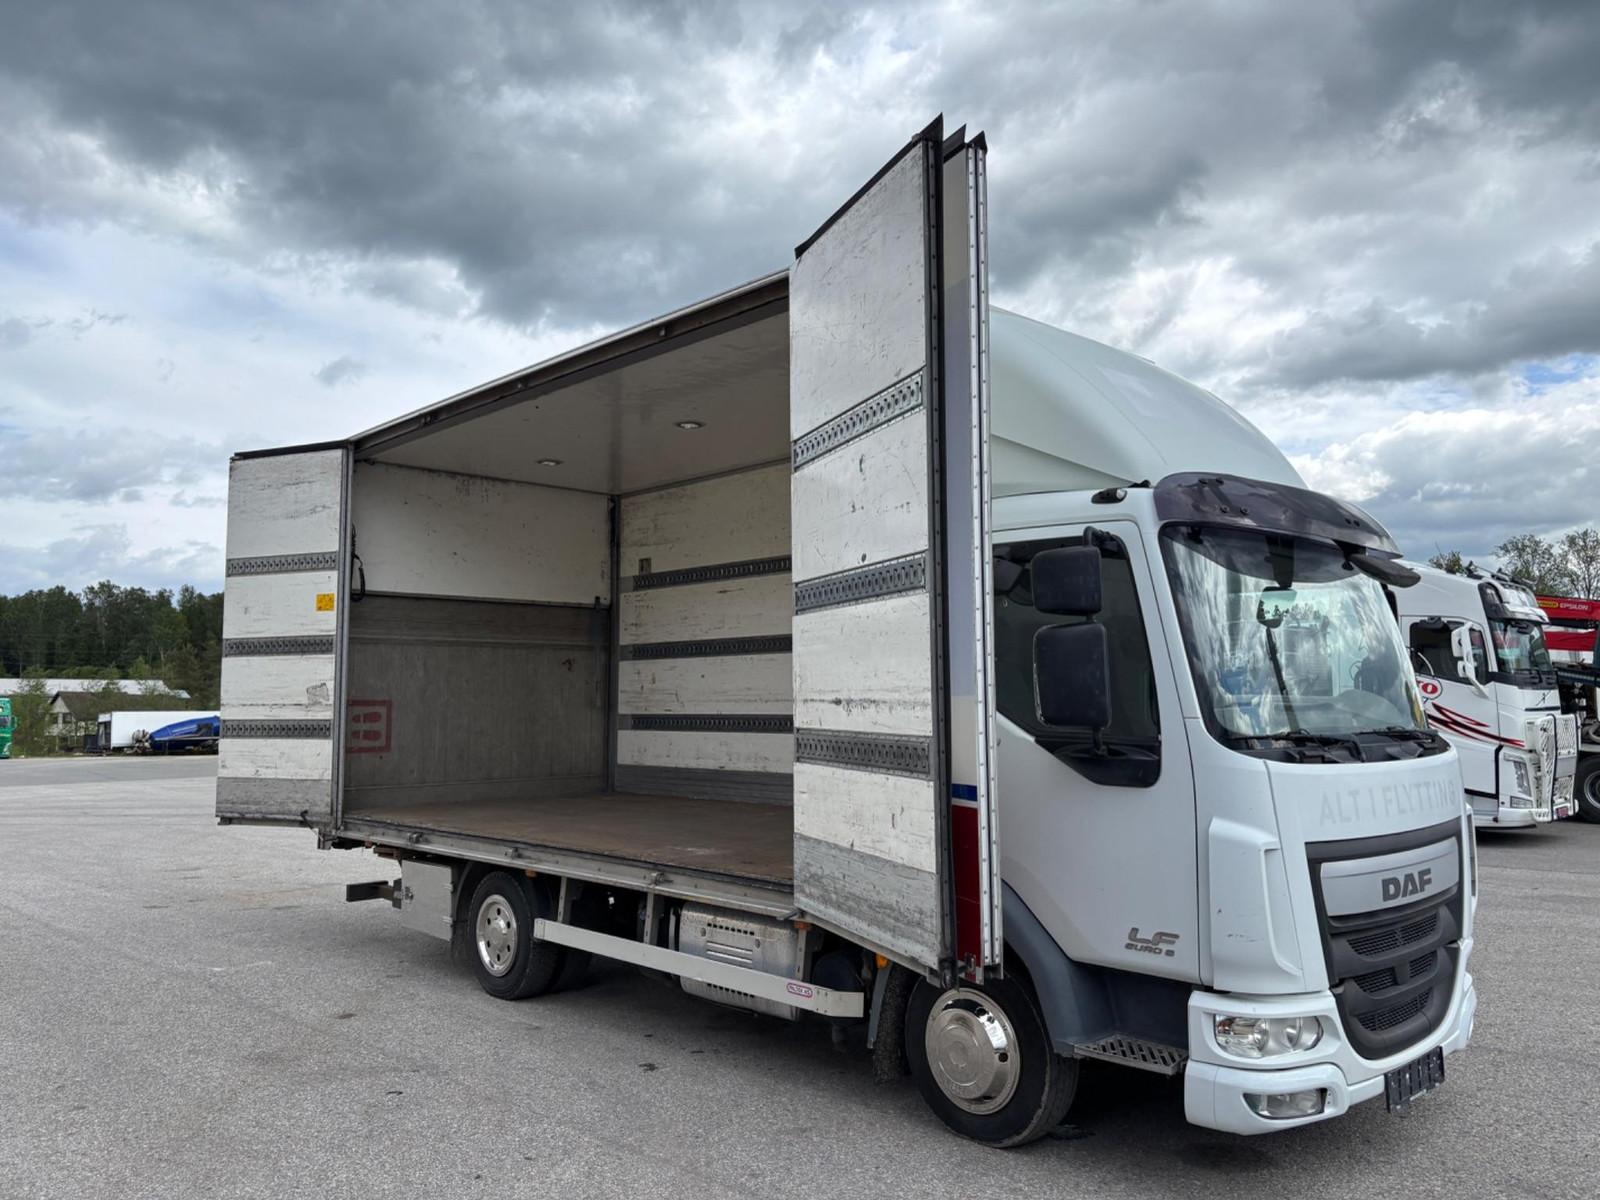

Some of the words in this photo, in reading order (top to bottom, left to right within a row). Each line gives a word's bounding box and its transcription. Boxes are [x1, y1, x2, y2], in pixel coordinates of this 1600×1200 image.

[1319, 789, 1361, 826] ALT
[1381, 868, 1432, 901] DAF
[1125, 942, 1163, 954] EURO
[1128, 927, 1180, 946] LF
